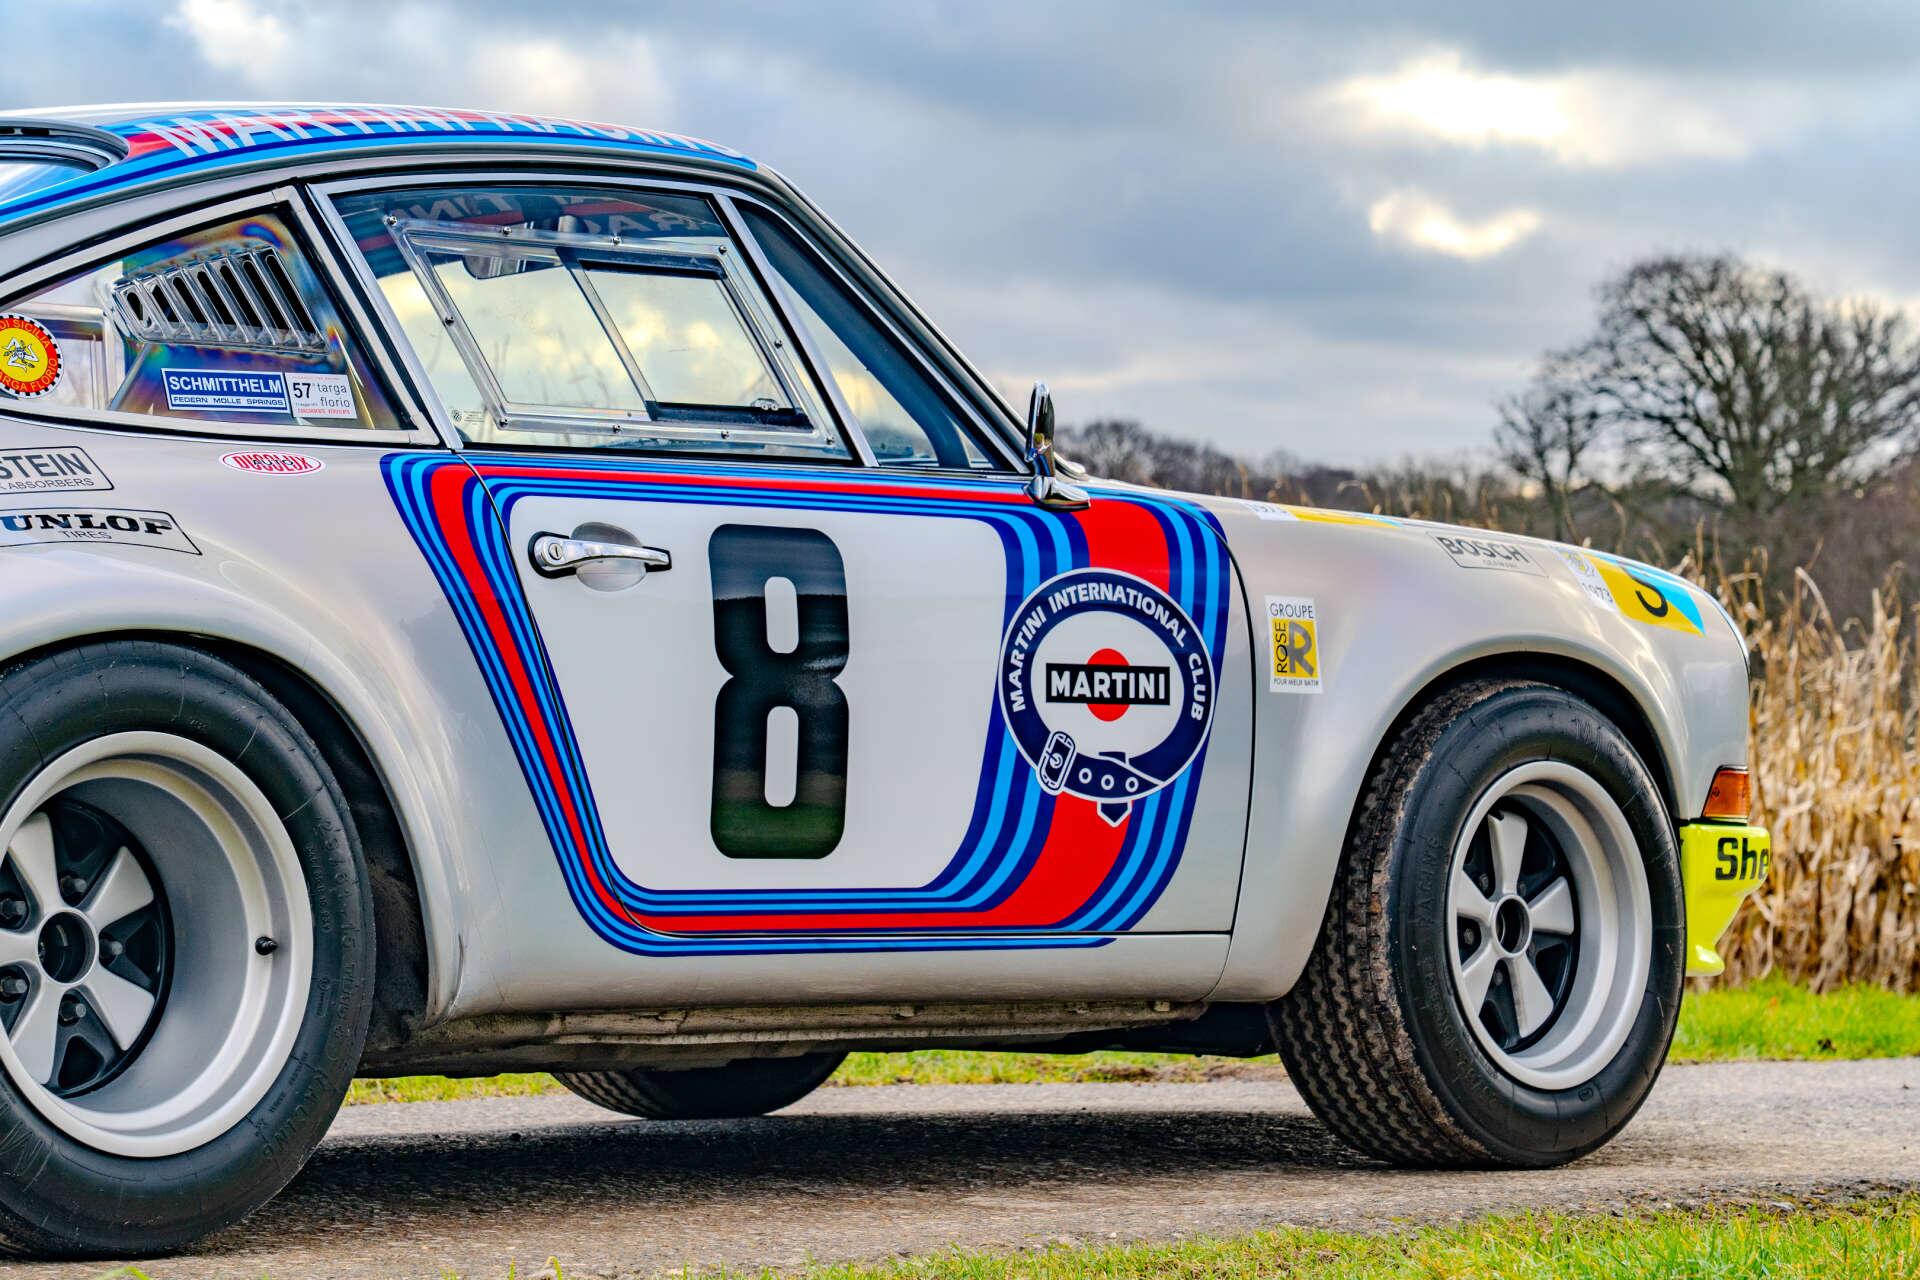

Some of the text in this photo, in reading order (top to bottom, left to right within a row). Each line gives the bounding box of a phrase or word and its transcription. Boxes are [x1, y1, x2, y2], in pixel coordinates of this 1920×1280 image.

[133, 107, 478, 157] MARTINI
[13, 319, 51, 349] SICILIA
[31, 358, 58, 391] FLORIO
[169, 376, 283, 393] SCHMITTHELM
[174, 396, 208, 404] FEDERN
[317, 383, 347, 395] targa
[320, 396, 351, 408] florio
[8, 477, 95, 490] ABSORBERS
[58, 530, 113, 540] TIRES
[1436, 536, 1531, 564] BOSCH
[1270, 602, 1314, 619] GROUPE
[1009, 582, 1207, 721] MARTINI INTERNATIONAL CLUB
[1274, 621, 1289, 674] ROSE
[708, 523, 849, 860] 8
[1050, 670, 1166, 700] MARTINI
